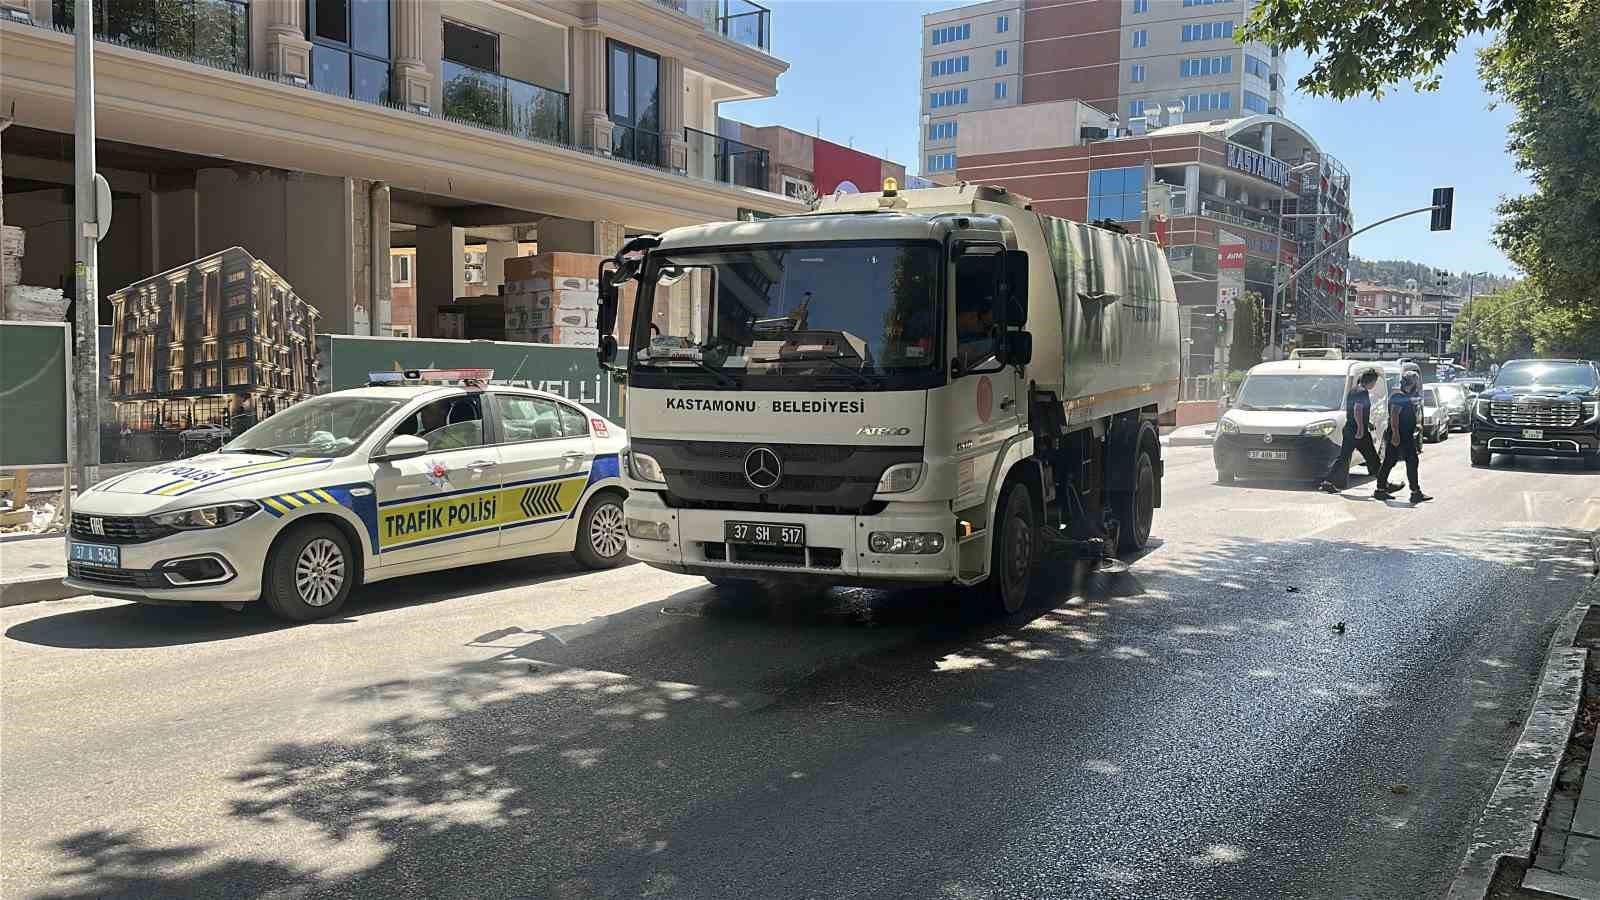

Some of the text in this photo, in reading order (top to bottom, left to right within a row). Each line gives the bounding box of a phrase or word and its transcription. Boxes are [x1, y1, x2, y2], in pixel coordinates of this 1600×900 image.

[666, 397, 865, 413] KASTAMONU BELEDİYESİ
[385, 496, 496, 537] TRAFİK POLİSİ
[734, 525, 801, 543] 37 SH 517
[76, 545, 84, 559] 37
